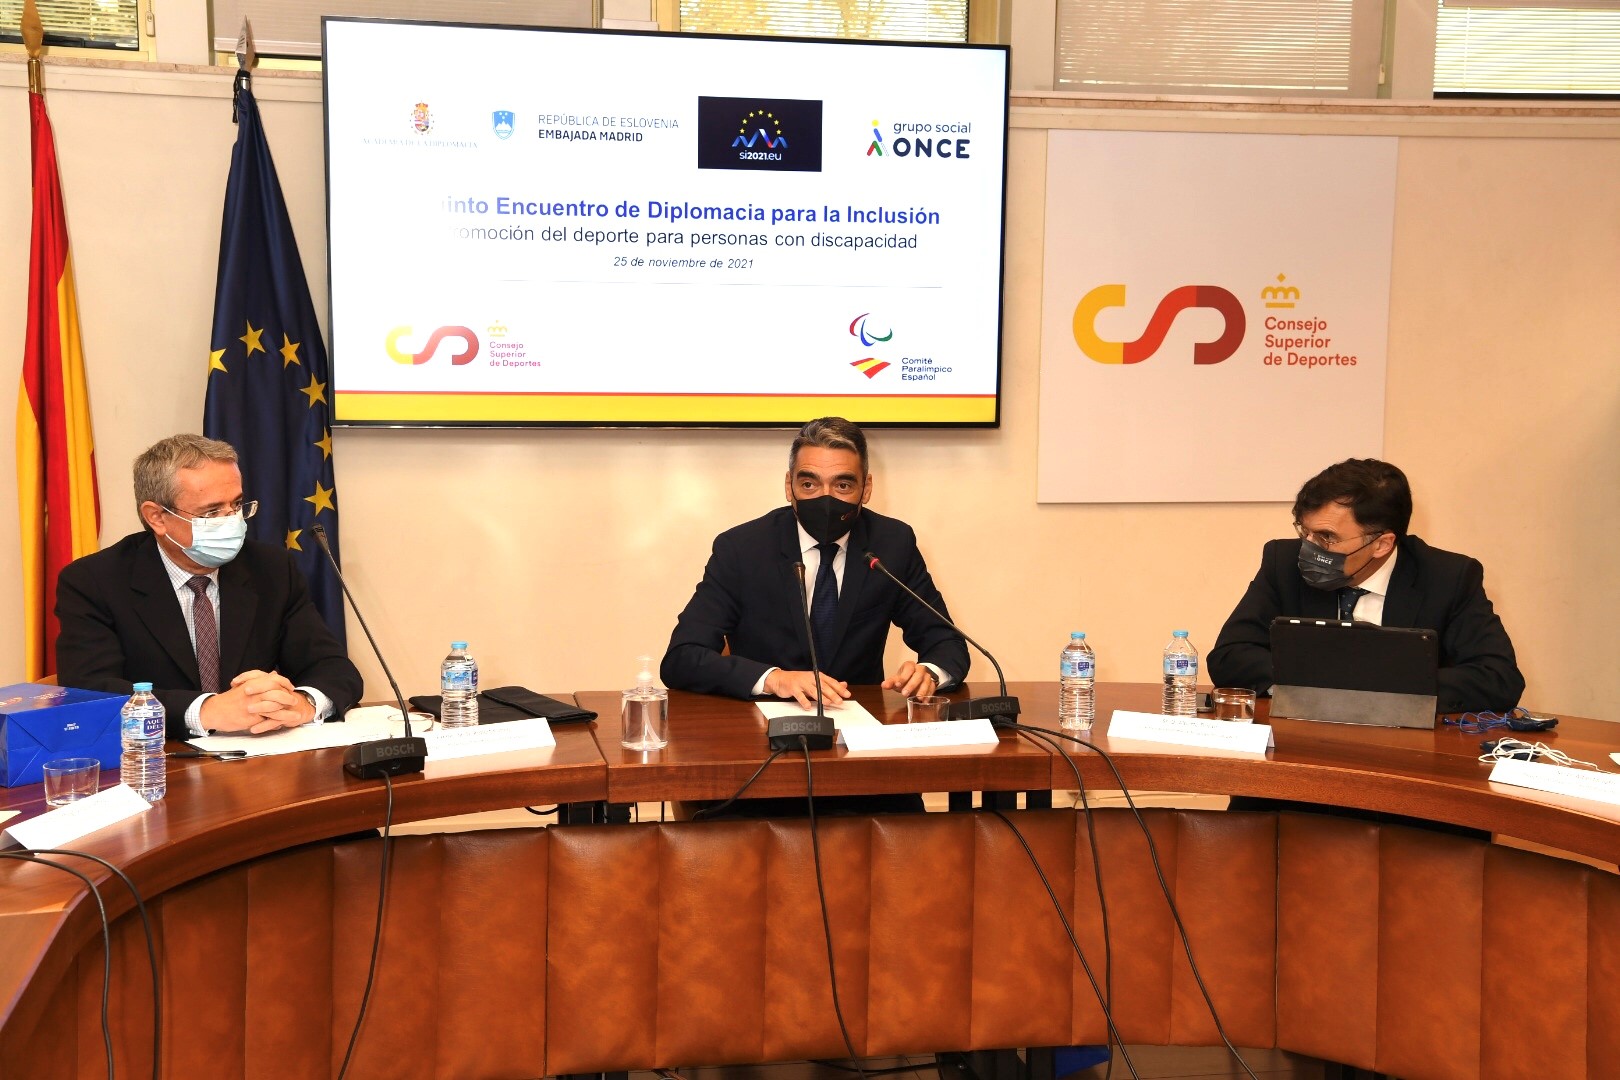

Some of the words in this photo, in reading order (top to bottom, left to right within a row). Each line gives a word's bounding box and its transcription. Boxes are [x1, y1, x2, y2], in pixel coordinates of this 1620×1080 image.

[539, 114, 599, 126] REPÚBLICA
[603, 117, 616, 126] DE
[621, 118, 678, 128] ESLOVENIA
[894, 123, 932, 134] grupo
[936, 122, 971, 133] social
[539, 129, 596, 141] EMBAJADA
[600, 132, 642, 142] MADRID
[739, 150, 781, 160] si2021.eu
[893, 138, 970, 159] ONCE
[497, 197, 608, 217] Encuentro
[615, 201, 640, 218] de
[649, 201, 764, 223] Diplomacia
[772, 209, 816, 225] para
[824, 206, 840, 222] la
[848, 206, 939, 224] Inclusión
[542, 226, 566, 241] del
[574, 227, 638, 245] deporte
[647, 232, 683, 246] para
[691, 233, 767, 247] personas
[775, 235, 804, 246] con
[811, 232, 917, 251] discapacidad
[614, 257, 627, 266] 25
[631, 257, 644, 266] de
[649, 258, 706, 267] noviembre
[710, 259, 723, 268] de
[728, 259, 753, 268] 2021
[1264, 315, 1328, 334] Consejo
[489, 341, 525, 350] Consejo
[1264, 334, 1332, 351] Superior
[489, 350, 527, 359] Superior
[901, 357, 933, 365] Comité
[1263, 352, 1283, 366] de
[1287, 352, 1358, 369] Deportes
[489, 359, 502, 367] de
[502, 359, 542, 368] Deportes
[901, 373, 936, 382] Español
[982, 700, 1011, 713] BOSCH
[782, 721, 821, 732] BOSCH
[376, 743, 415, 758] BOSCH
